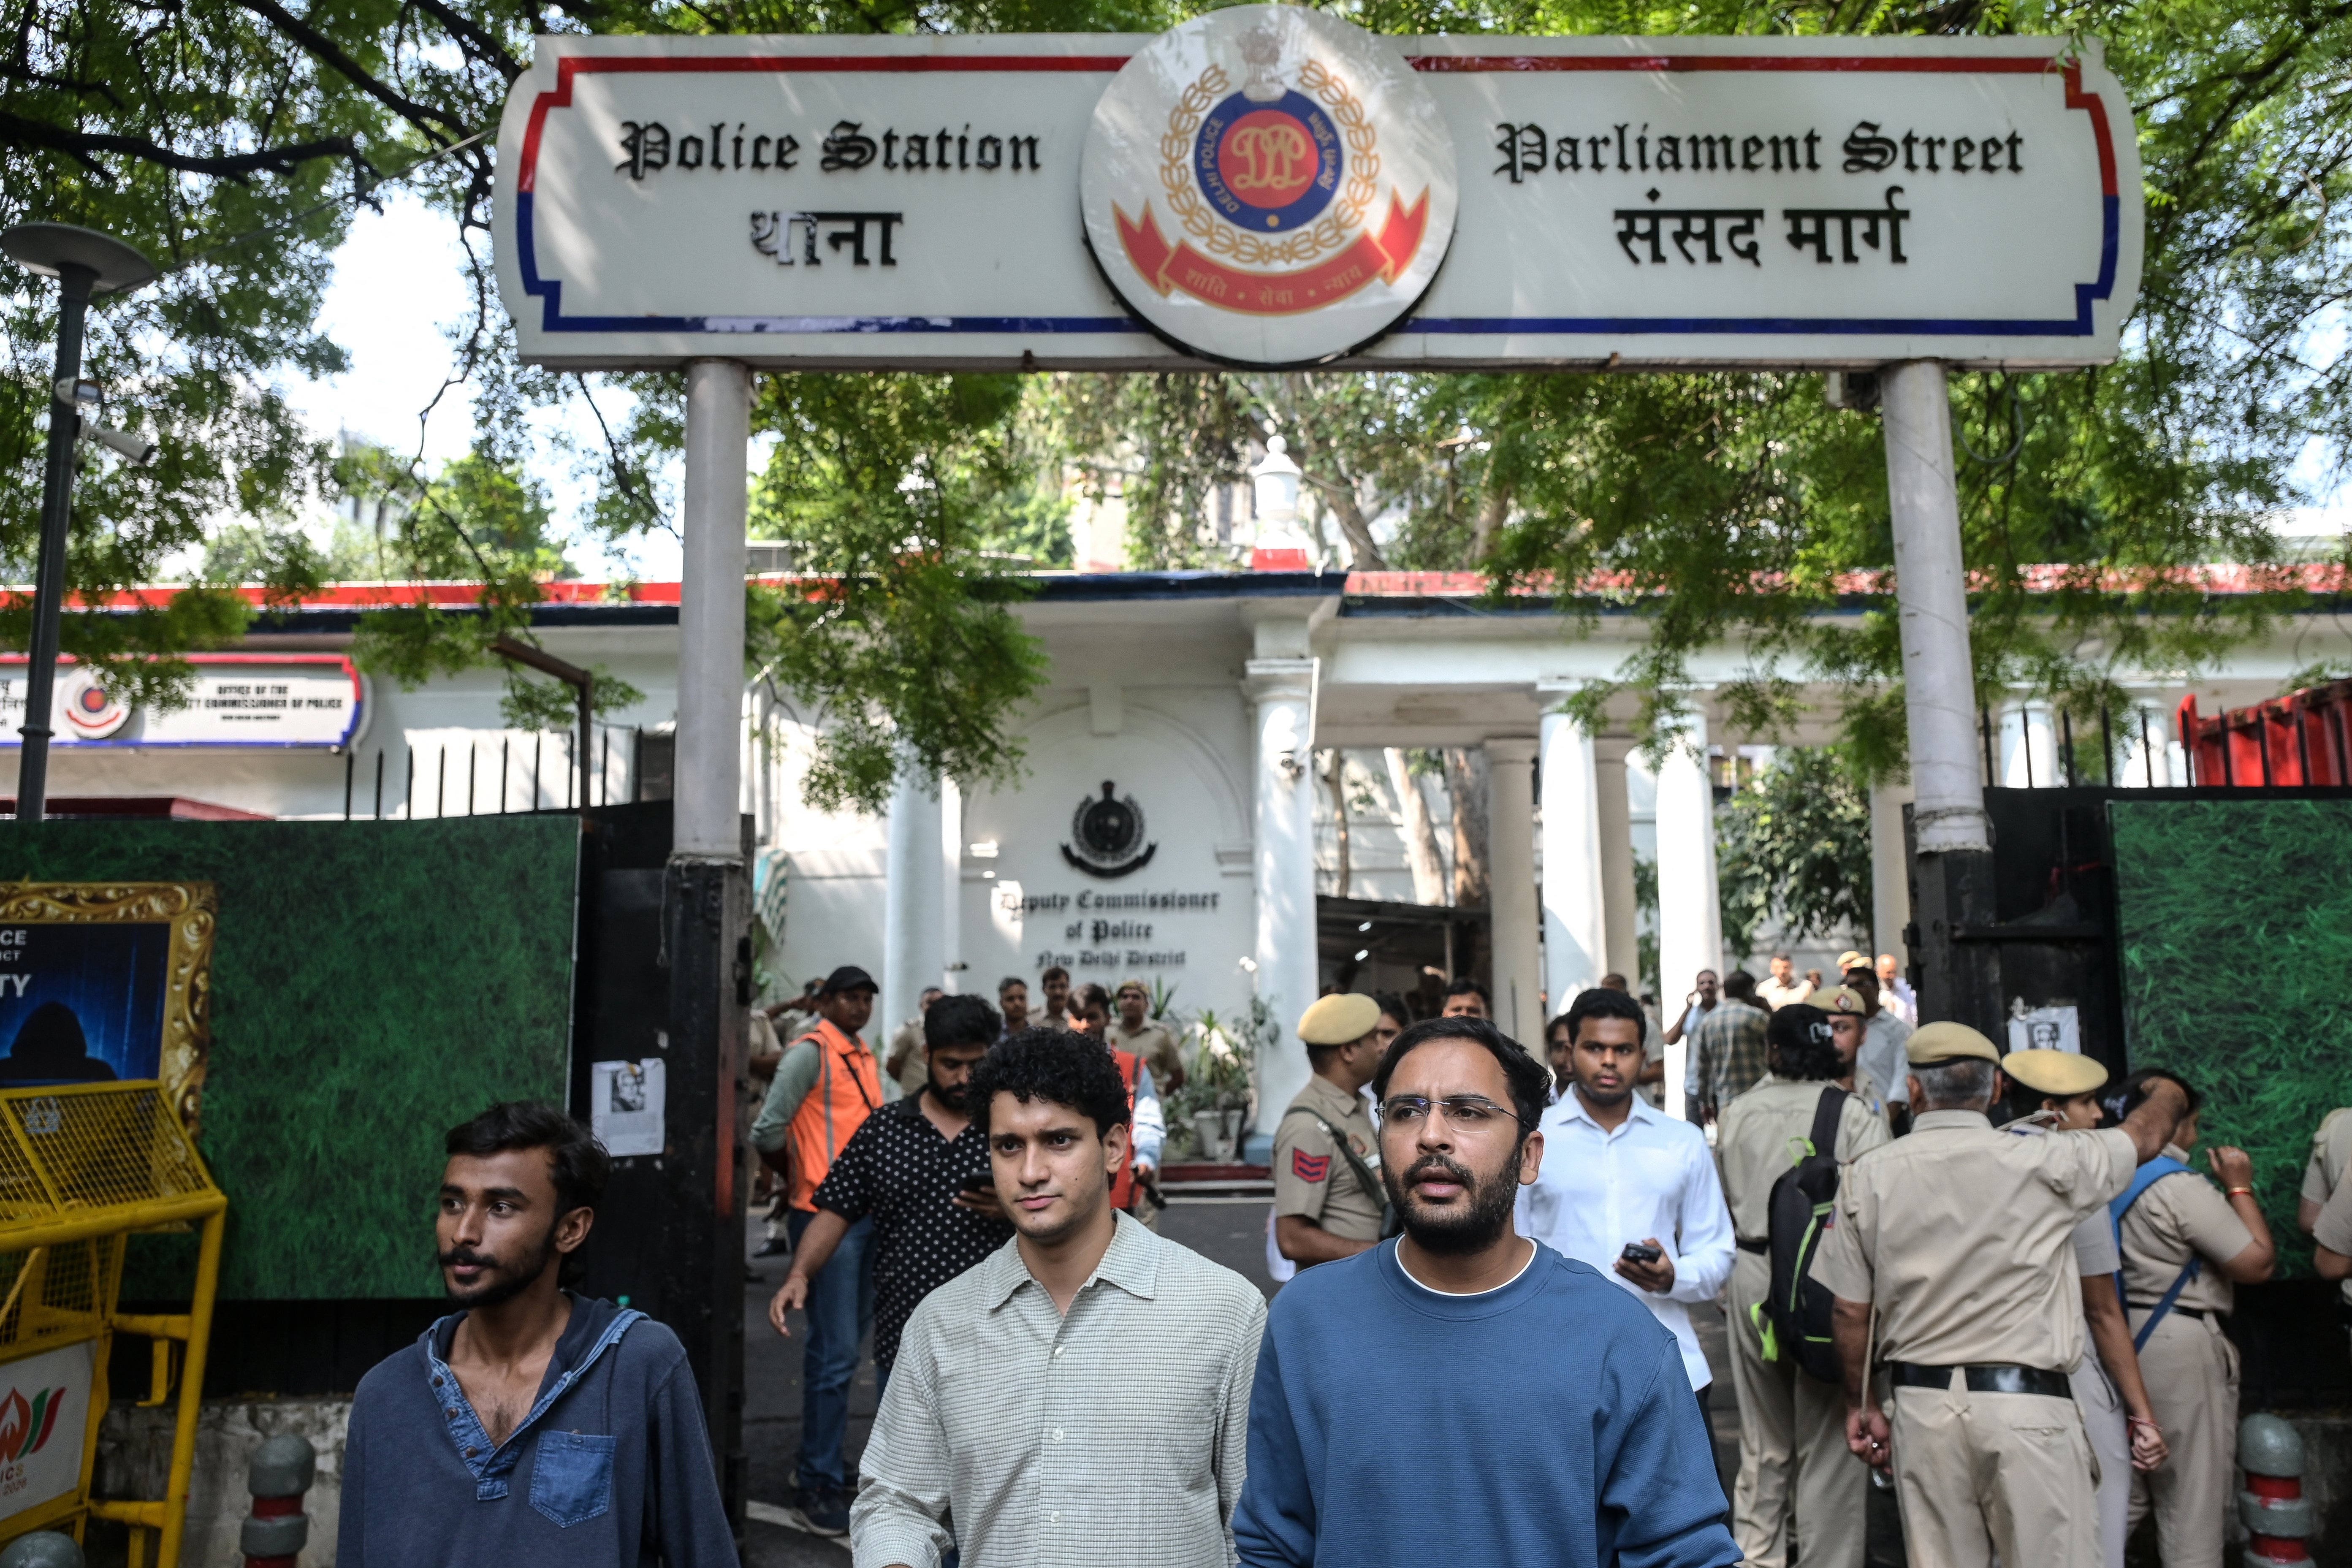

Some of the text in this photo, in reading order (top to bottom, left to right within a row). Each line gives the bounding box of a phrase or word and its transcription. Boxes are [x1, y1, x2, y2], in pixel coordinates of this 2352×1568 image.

[615, 119, 1041, 180] Police Station
[1201, 117, 1240, 214] DELHI POLICE
[1493, 121, 2024, 184] Parliament Street
[750, 211, 903, 267] थाना
[1613, 185, 1909, 267] संसद मार्ग
[205, 699, 286, 708] COMMISSIONER
[292, 699, 303, 708] OF
[308, 699, 342, 708] POLICE
[1076, 888, 1220, 909] Commissioner
[1066, 919, 1153, 944] of Police
